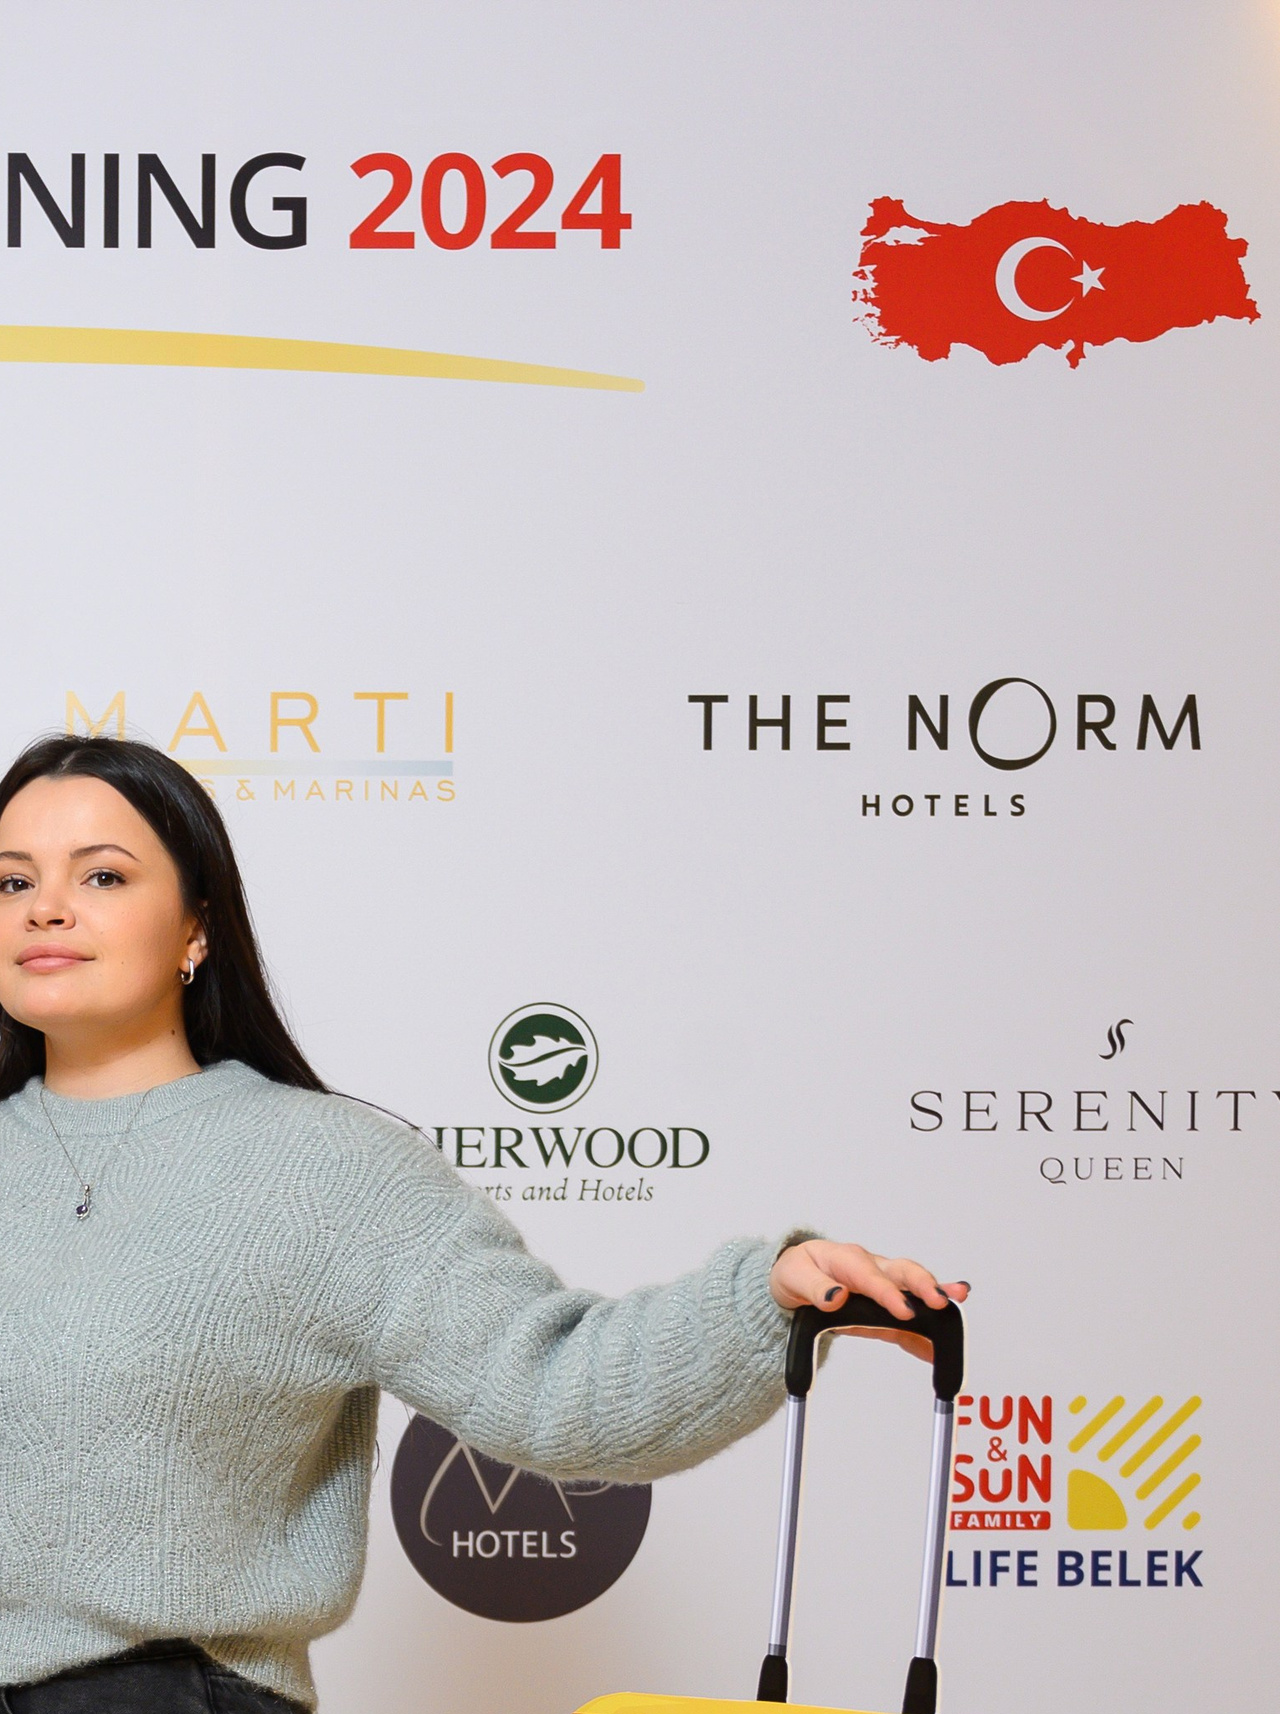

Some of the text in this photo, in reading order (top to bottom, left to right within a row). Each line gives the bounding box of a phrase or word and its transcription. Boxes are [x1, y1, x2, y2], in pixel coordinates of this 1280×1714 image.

[349, 152, 634, 250] 2024
[65, 690, 454, 753] MARTI
[687, 677, 1202, 771] THE NORM
[273, 779, 456, 802] MARINAS
[861, 794, 1026, 817] HOTELS
[909, 1090, 1280, 1132] SERENIT
[419, 1126, 711, 1169] ERWOOD
[1039, 1156, 1184, 1184] QUEEN
[521, 1177, 568, 1202] and
[578, 1179, 654, 1203] Hotels
[987, 1436, 1008, 1462] &
[951, 1454, 1052, 1504] SUN
[953, 1512, 1042, 1529] FAMILY
[452, 1530, 577, 1559] HOTELS
[945, 1550, 1204, 1588] LIFE BELEK
